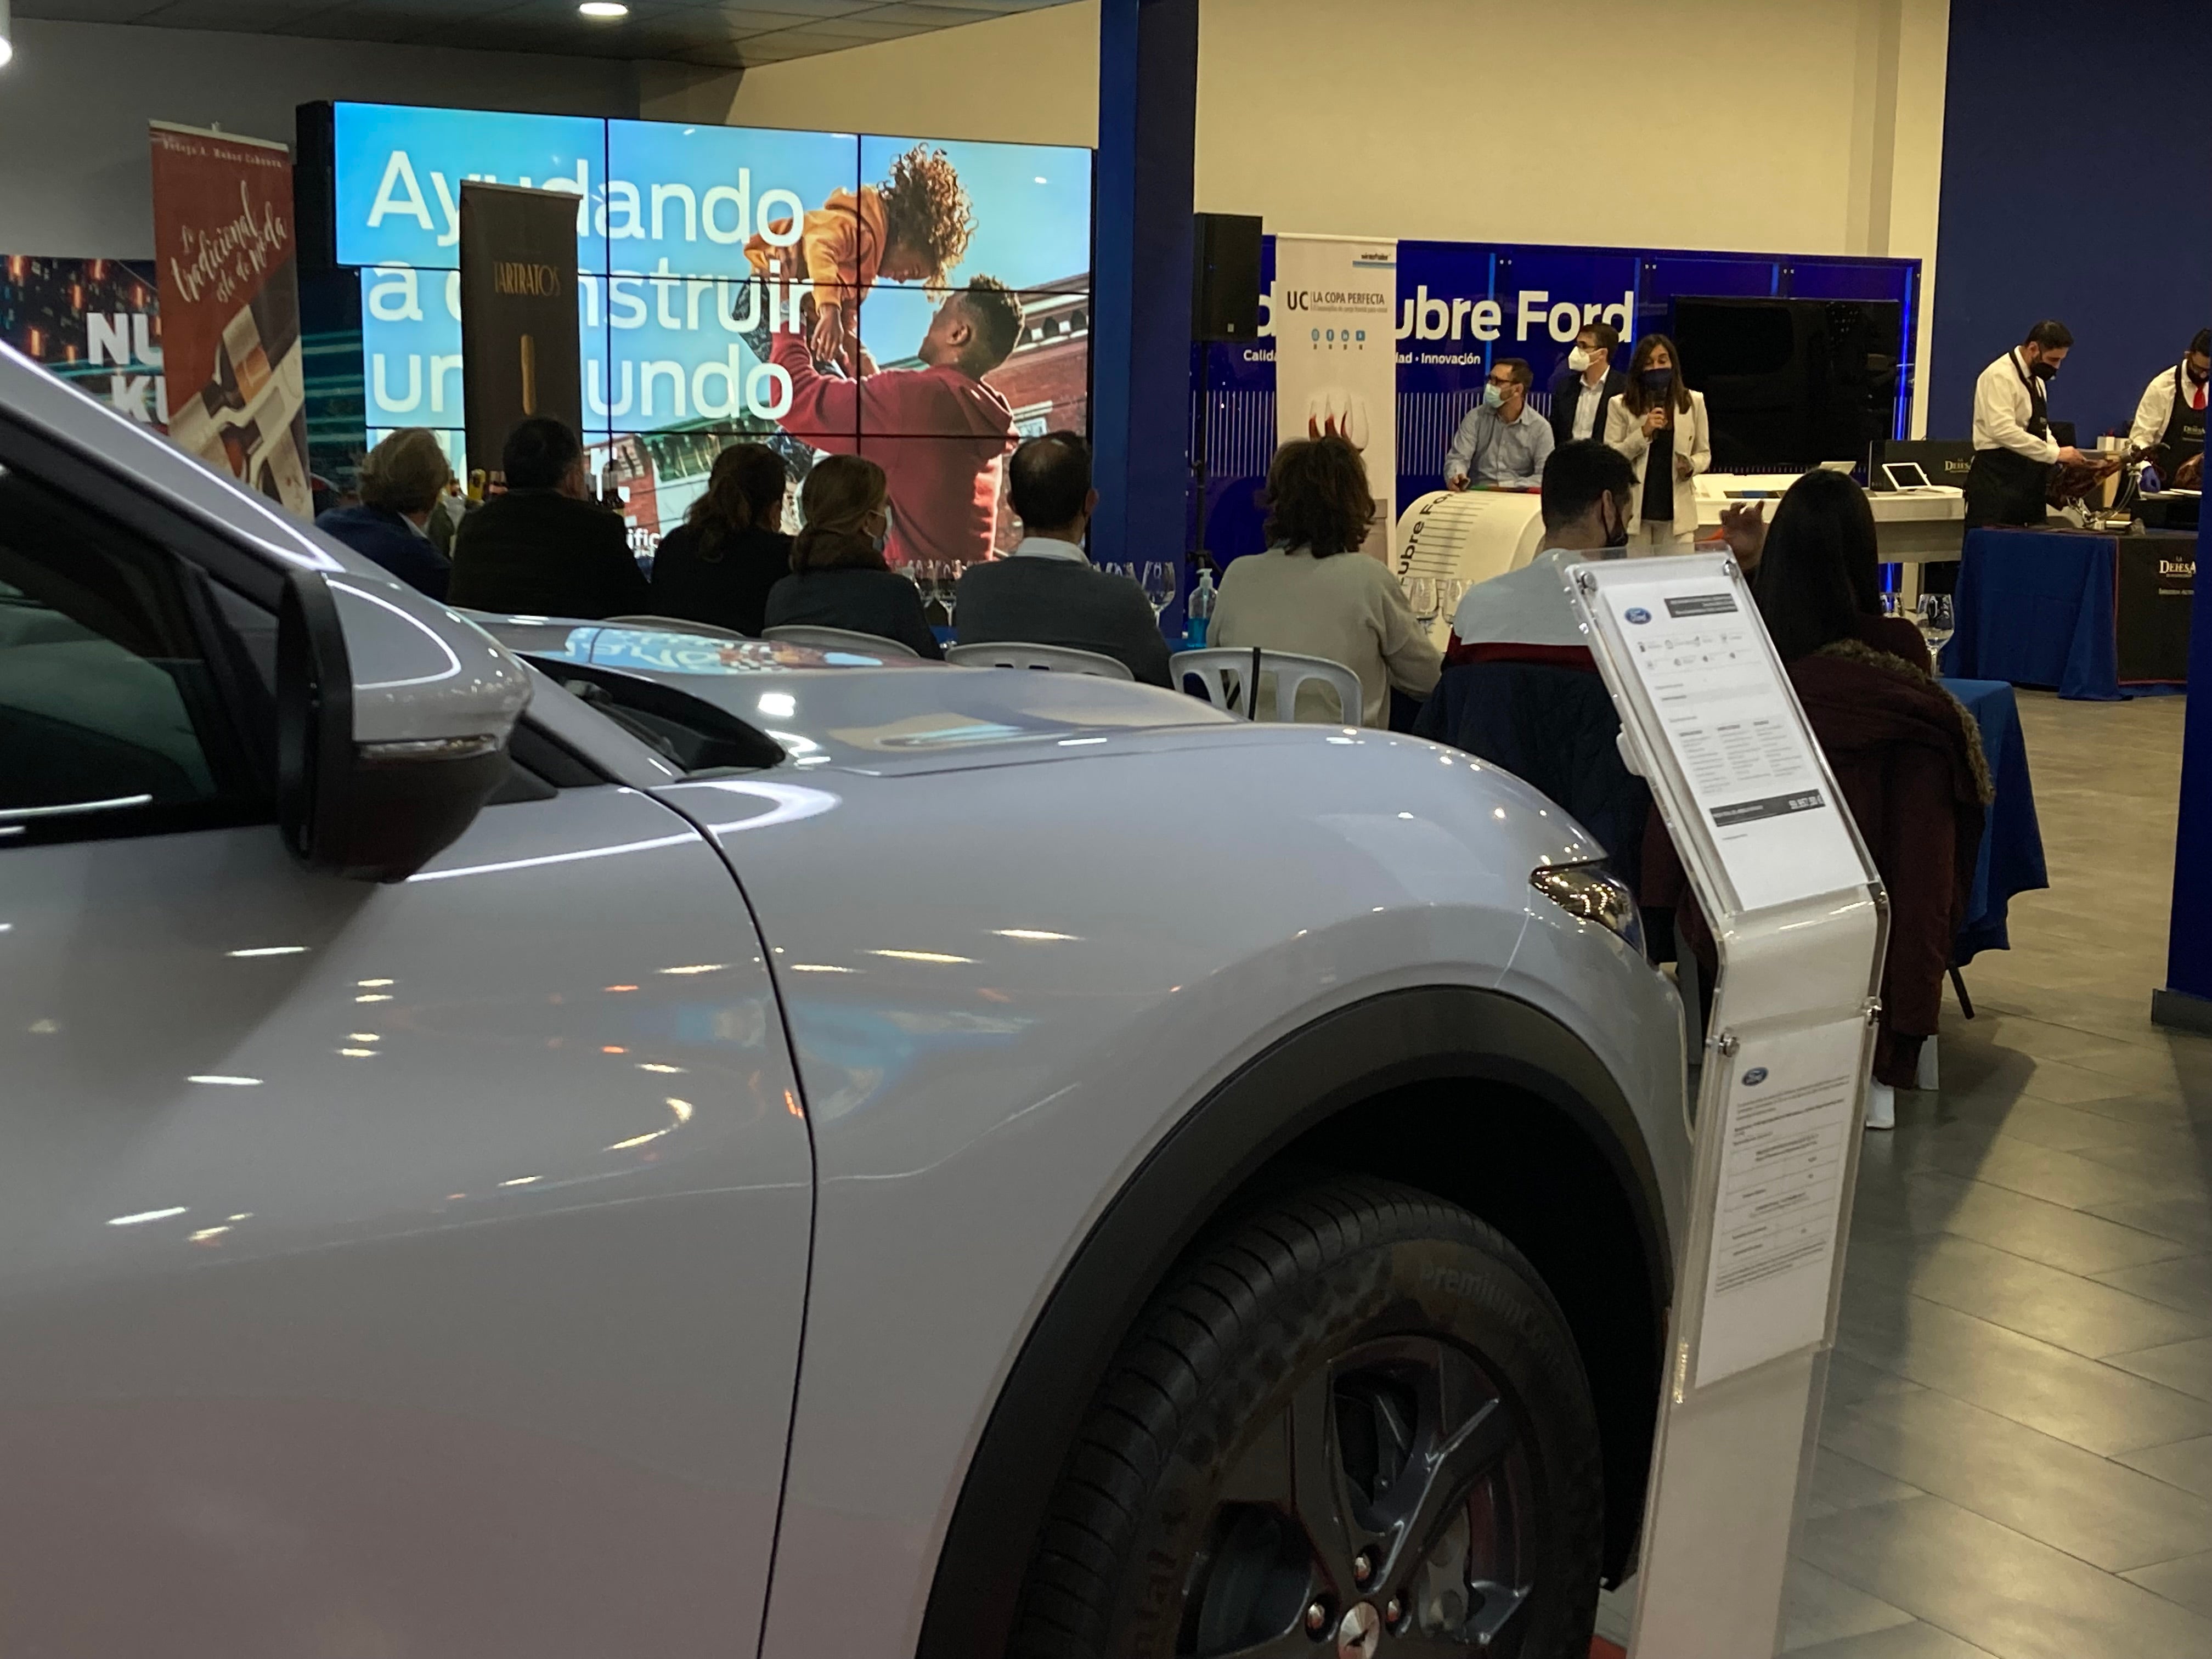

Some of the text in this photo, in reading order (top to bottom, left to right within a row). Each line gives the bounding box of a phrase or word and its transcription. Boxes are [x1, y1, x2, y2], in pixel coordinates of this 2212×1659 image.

[369, 261, 423, 321] a
[1287, 291, 1309, 311] UC
[1325, 292, 1346, 303] COPA
[1347, 293, 1385, 304] PERFECTA
[1516, 290, 1634, 343] Ford
[587, 343, 793, 420] undo
[1421, 353, 1481, 365] Innovación
